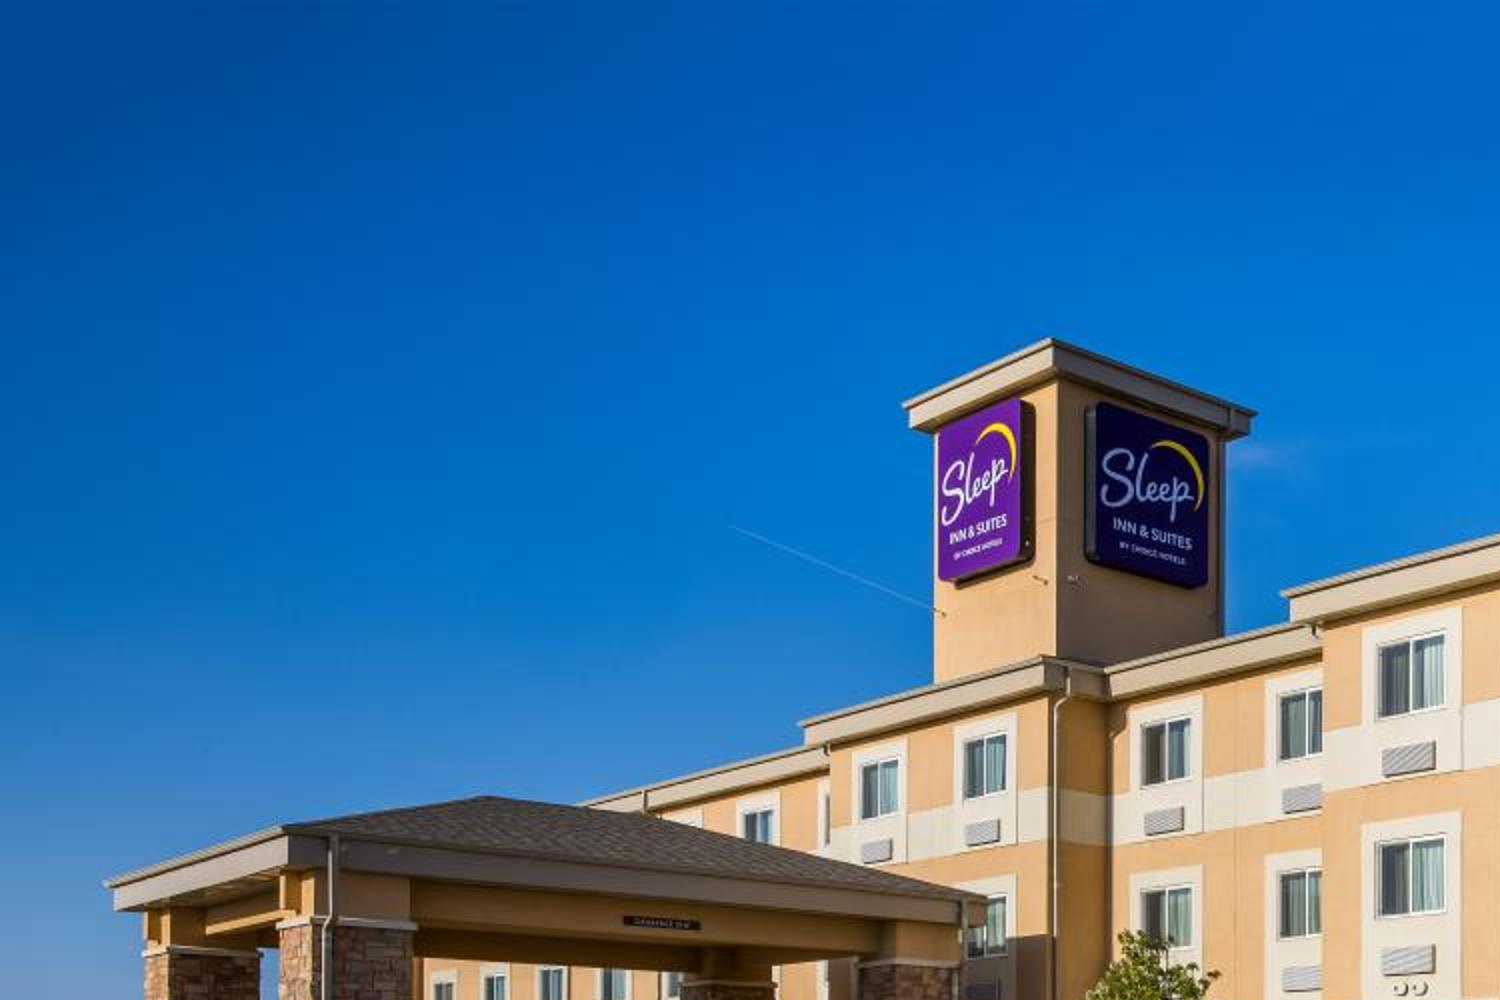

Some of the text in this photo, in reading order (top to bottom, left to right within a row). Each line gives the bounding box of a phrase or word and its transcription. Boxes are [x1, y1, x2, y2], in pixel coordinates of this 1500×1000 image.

[941, 452, 1009, 526] Sleep
[1101, 447, 1195, 523] Sleep
[949, 528, 966, 545] INN
[968, 525, 975, 539] &
[976, 513, 1007, 535] SUITES
[1113, 516, 1193, 550] INN & SUITES
